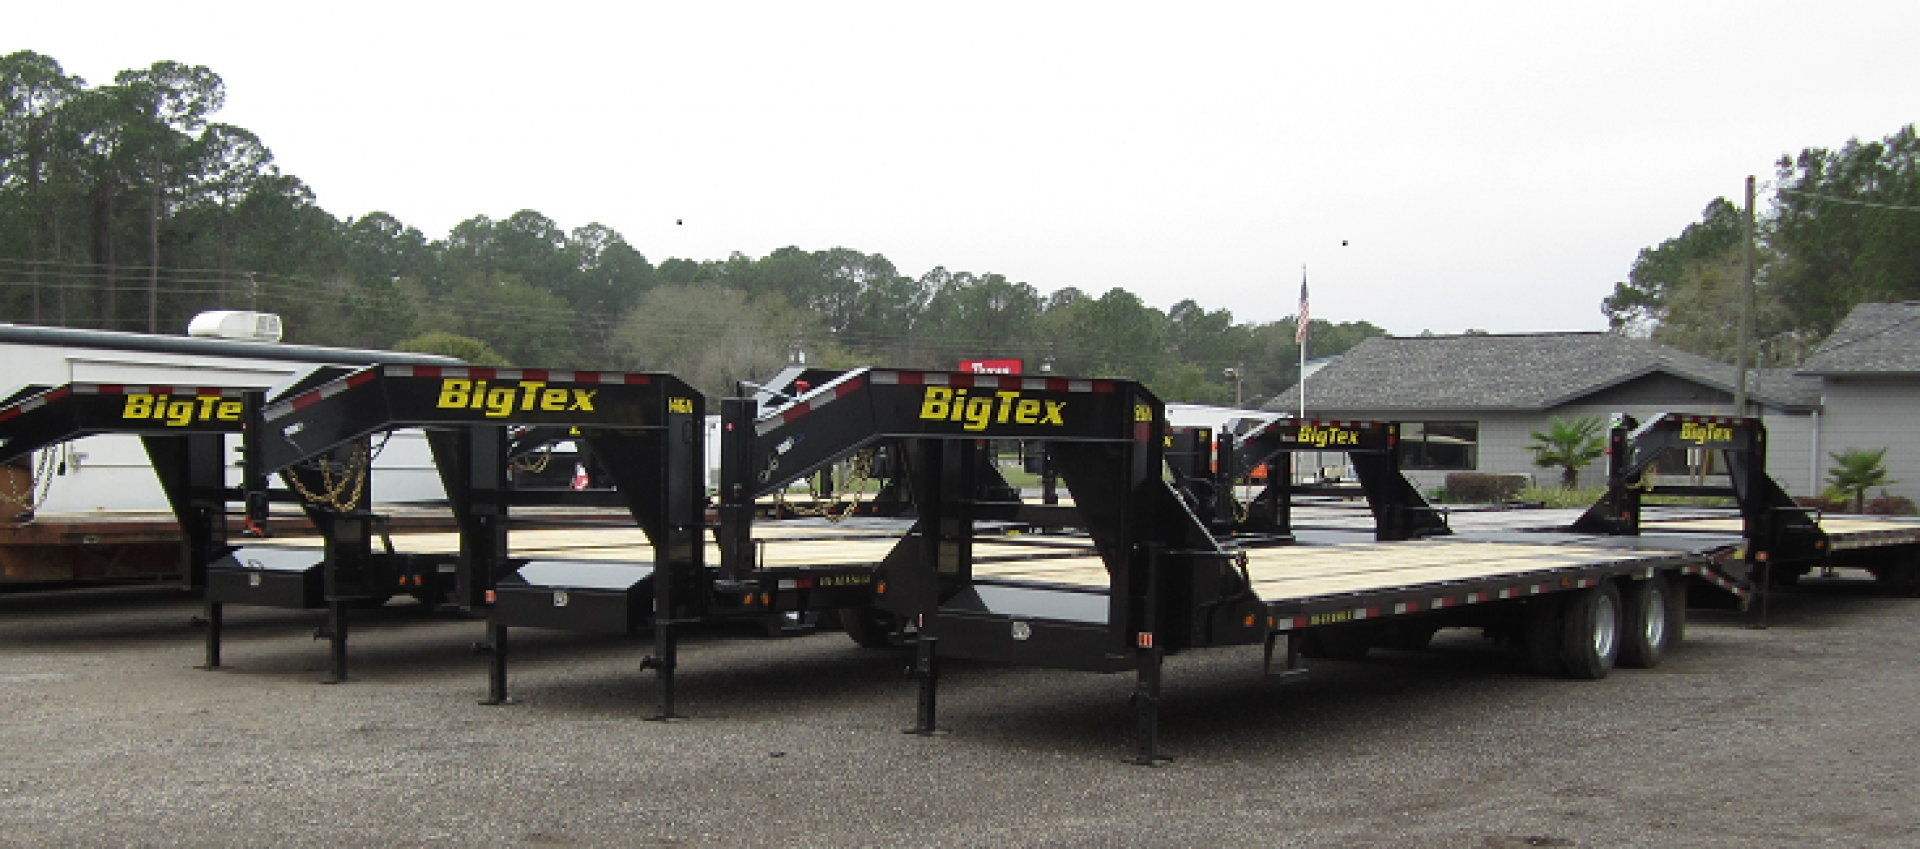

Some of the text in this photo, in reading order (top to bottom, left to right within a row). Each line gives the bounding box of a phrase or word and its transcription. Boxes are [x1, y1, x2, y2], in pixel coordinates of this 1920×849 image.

[122, 394, 243, 426] BigTe
[436, 378, 597, 418] BigTex
[919, 386, 1066, 431] BigTex
[1298, 425, 1359, 447] BigTex
[1680, 422, 1733, 444] BigTex
